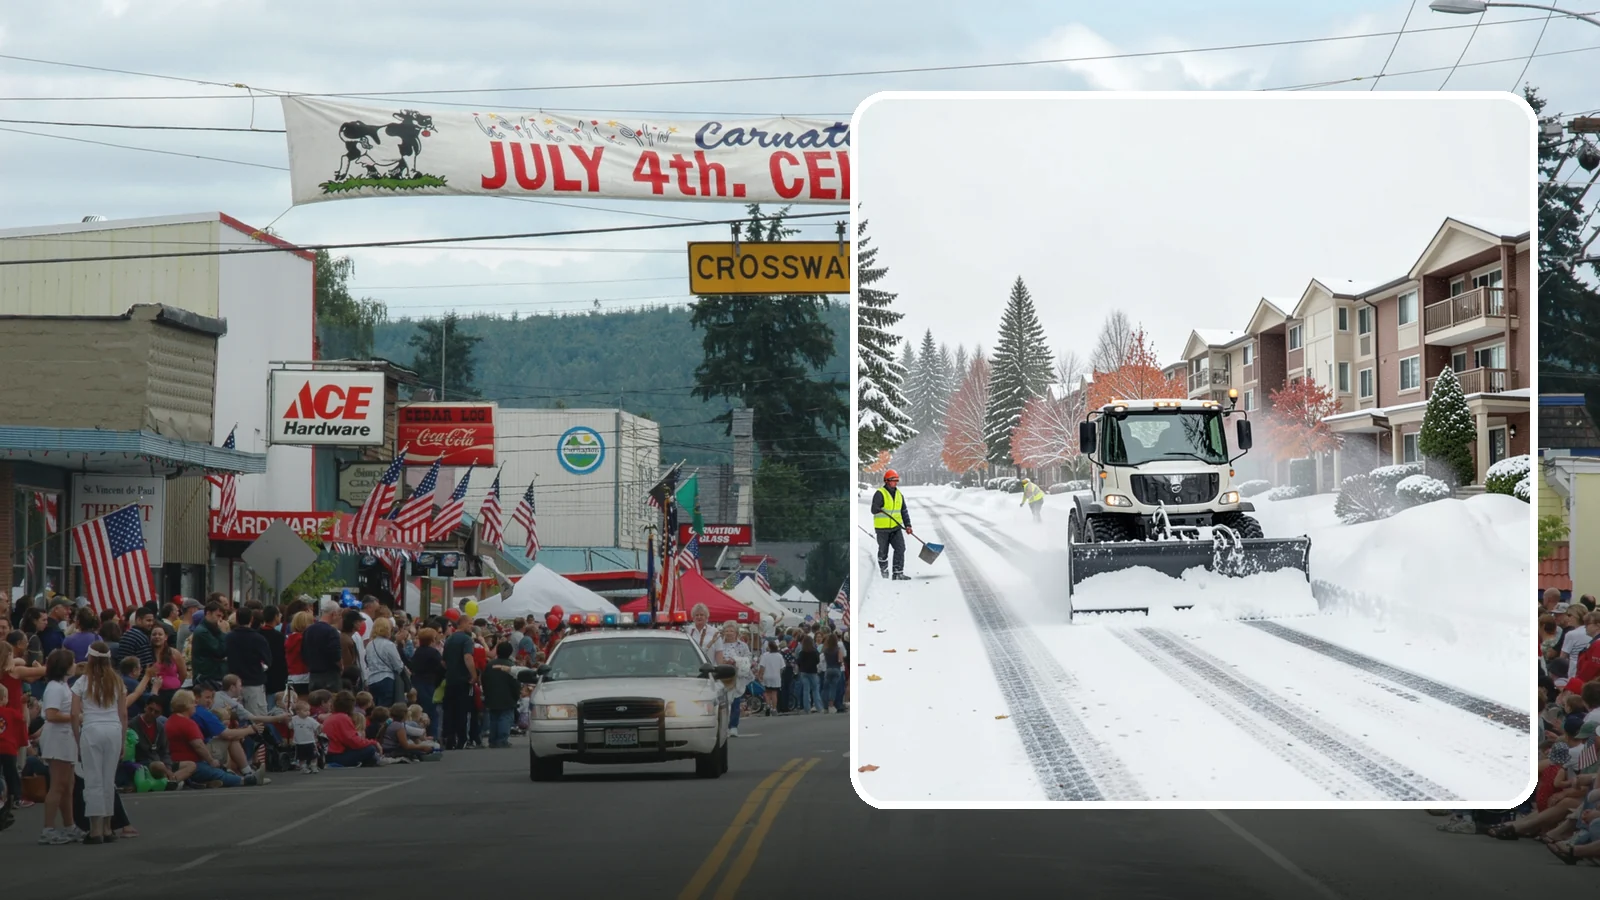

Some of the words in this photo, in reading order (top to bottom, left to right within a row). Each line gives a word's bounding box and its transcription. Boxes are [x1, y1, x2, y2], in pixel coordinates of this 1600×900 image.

[481, 140, 605, 193] JULY
[632, 150, 746, 198] 4th.
[697, 254, 850, 280] CROSSWA
[282, 380, 373, 420] ACE
[405, 408, 452, 421] CEDAR
[460, 408, 485, 421] LOG
[283, 421, 370, 436] Hardware
[96, 484, 124, 494] Vincent
[126, 485, 136, 495] de
[137, 485, 155, 495] Paul
[688, 526, 741, 535] CRNATION
[699, 535, 730, 543] GLASS
